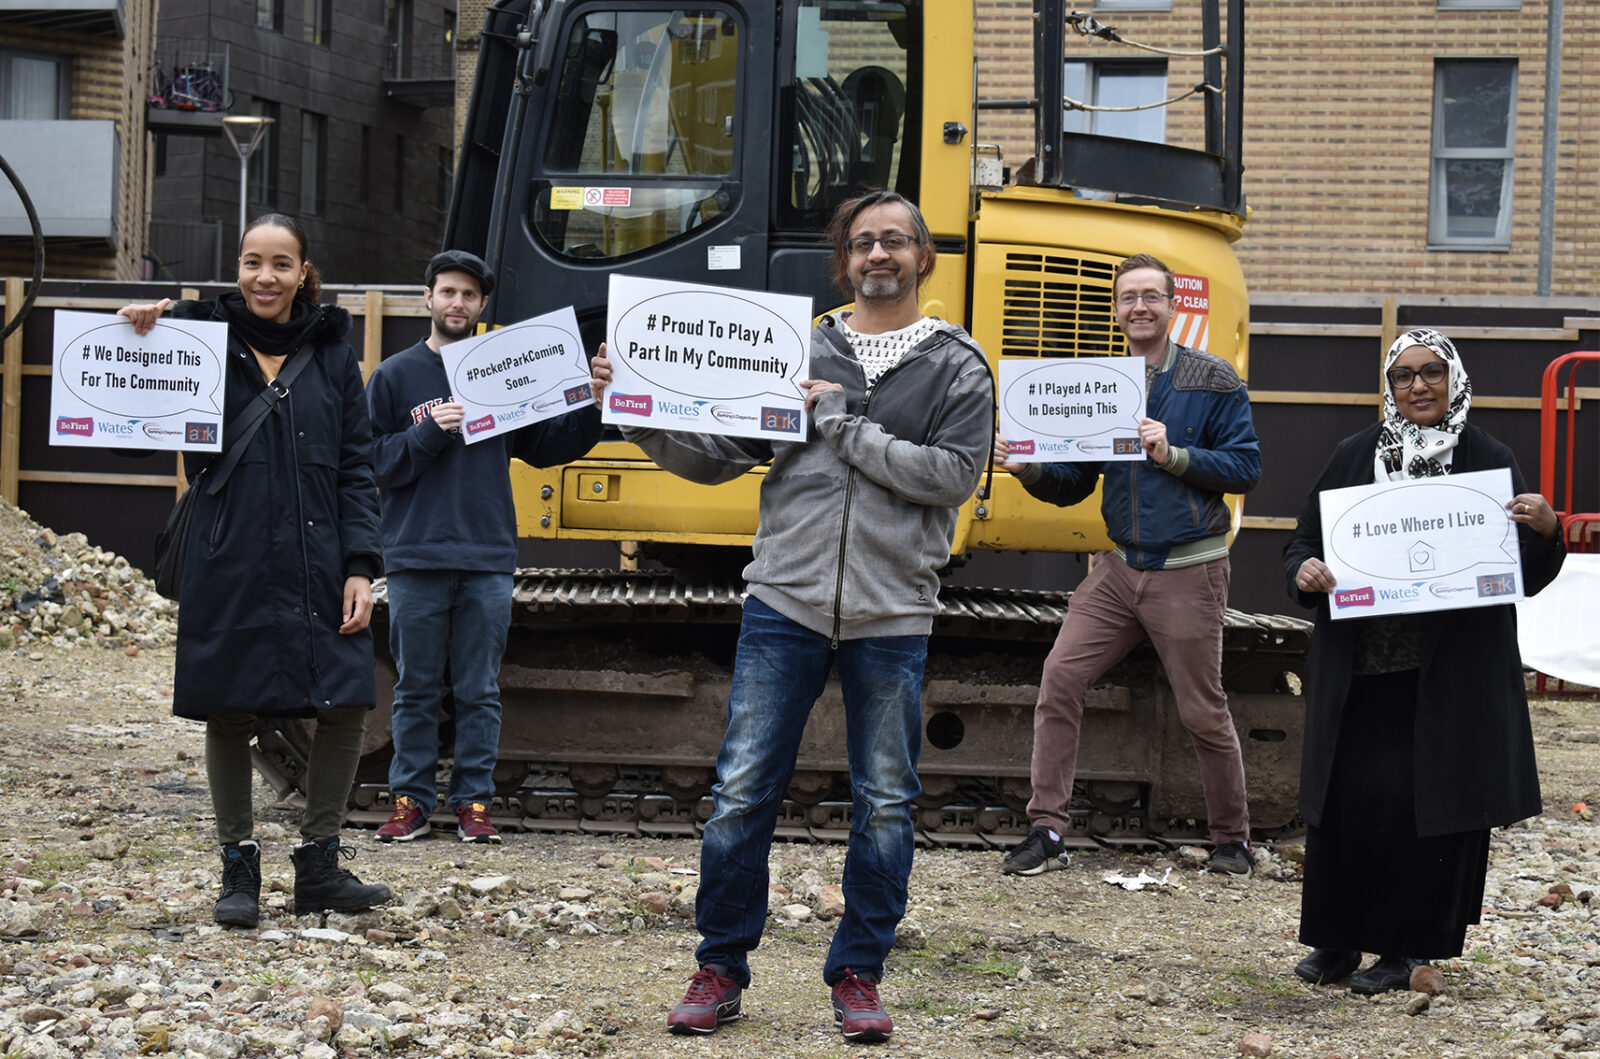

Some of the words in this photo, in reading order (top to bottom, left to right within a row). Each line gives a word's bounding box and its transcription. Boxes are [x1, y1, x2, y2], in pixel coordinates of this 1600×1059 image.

[1184, 296, 1208, 310] CLEAR
[646, 314, 657, 331] #
[662, 315, 704, 336] Proud
[708, 320, 724, 339] To
[728, 323, 760, 347] Play
[764, 327, 774, 344] A
[82, 344, 90, 360] #
[94, 345, 112, 362] We
[116, 347, 173, 368] Designed
[177, 351, 201, 366] This
[466, 342, 566, 382] #PocketParkComing
[628, 341, 660, 361] Part
[664, 345, 678, 363] In
[682, 347, 704, 370] My
[708, 350, 788, 379] Community
[81, 371, 101, 387] For
[104, 372, 126, 388] The
[130, 374, 200, 396] Community
[1028, 383, 1036, 396] #
[1038, 383, 1042, 395] I
[1045, 382, 1081, 398] Played
[1084, 382, 1092, 394] A
[1094, 381, 1118, 394] Part
[496, 408, 526, 424] Wates
[658, 401, 700, 416] Wates
[1028, 404, 1038, 416] In
[1042, 403, 1093, 418] Designing
[1096, 402, 1118, 414] This
[98, 422, 134, 434] Wates
[1038, 441, 1070, 452] Wates
[1352, 523, 1362, 538] #
[1366, 521, 1398, 536] Love
[1400, 517, 1444, 533] Where
[1448, 512, 1454, 528] I
[1457, 511, 1486, 527] Live
[1378, 586, 1420, 600] Wates
